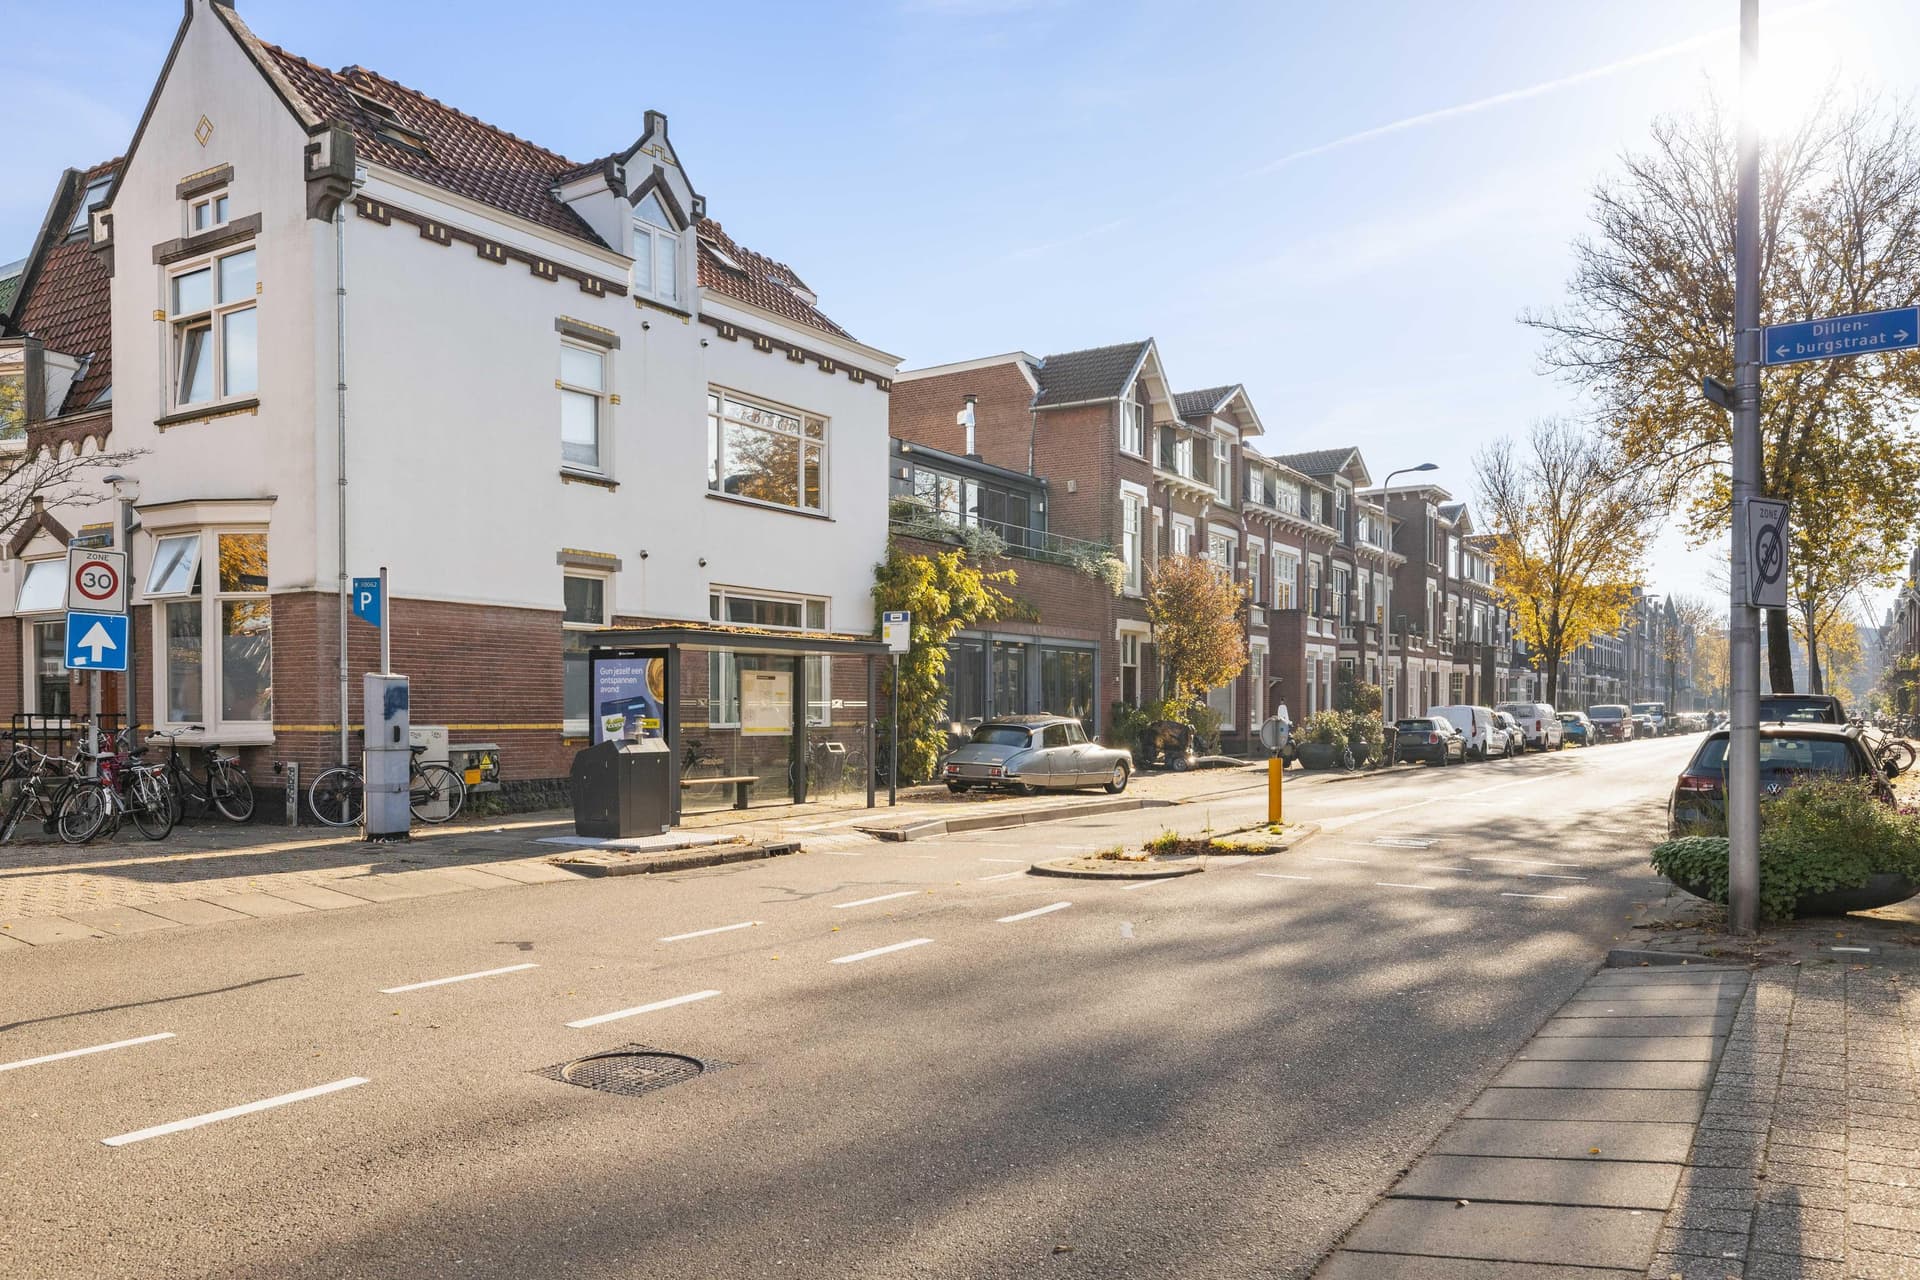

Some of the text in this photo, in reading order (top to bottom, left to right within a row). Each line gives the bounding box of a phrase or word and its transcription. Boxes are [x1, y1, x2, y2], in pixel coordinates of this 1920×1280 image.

[1813, 322, 1869, 337] Dillen-
[1796, 332, 1887, 354] burgstraat
[1759, 507, 1778, 520] ZONE
[86, 553, 110, 562] ZONE
[1761, 543, 1779, 566] 30
[83, 572, 111, 589] 30
[360, 591, 372, 611] P
[600, 677, 639, 686] ontspannen
[600, 685, 620, 693] avond
